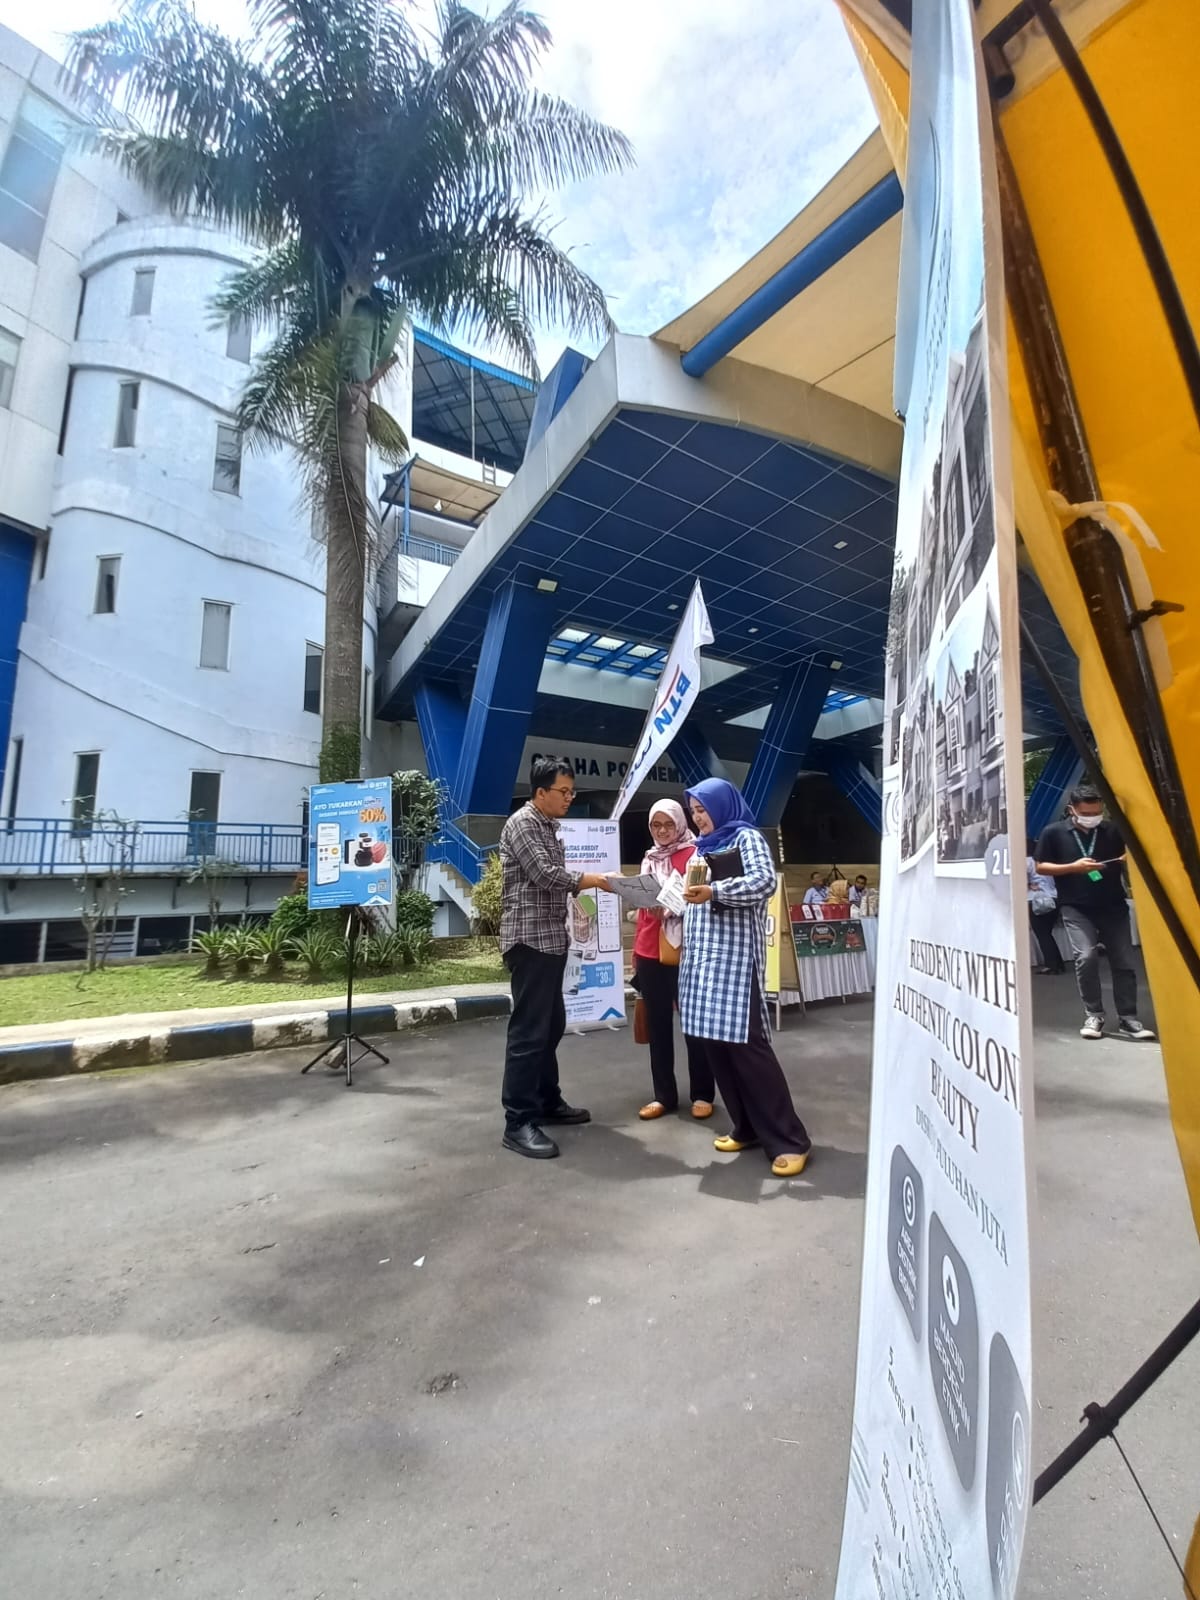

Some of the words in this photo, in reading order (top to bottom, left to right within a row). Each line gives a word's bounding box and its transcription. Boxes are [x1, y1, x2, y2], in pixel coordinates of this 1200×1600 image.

[654, 671, 692, 735] BTN
[909, 938, 962, 992] RESIDENCE
[963, 950, 1019, 1017] WITH
[893, 981, 952, 1052] AUTHENTIC
[930, 1057, 980, 1153] BEAUTY
[979, 1197, 1009, 1268] JUTA
[939, 1313, 966, 1385] MASJID
